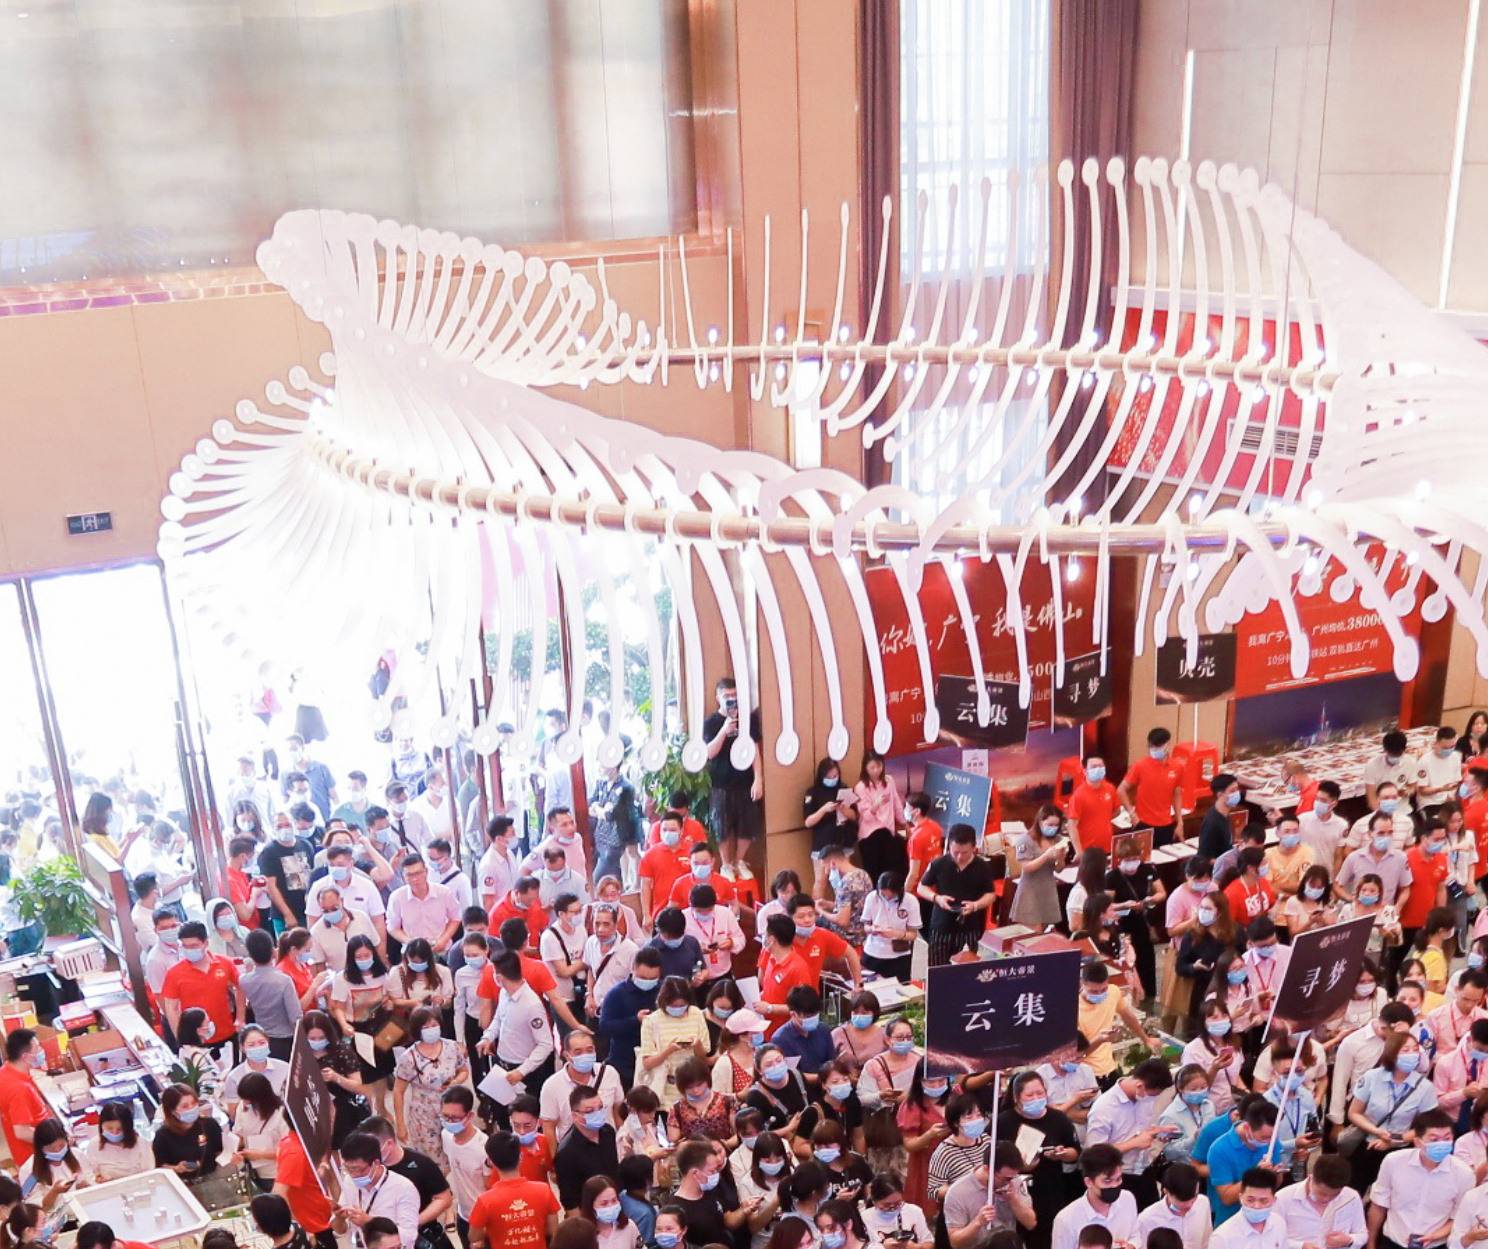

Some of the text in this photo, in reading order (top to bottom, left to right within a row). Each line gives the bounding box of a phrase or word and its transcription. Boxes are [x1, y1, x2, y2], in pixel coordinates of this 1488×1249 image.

[957, 702, 1009, 727] 云集
[935, 790, 973, 817] 云集
[1298, 958, 1348, 999] 寻梦
[961, 991, 1047, 1032] 云集
